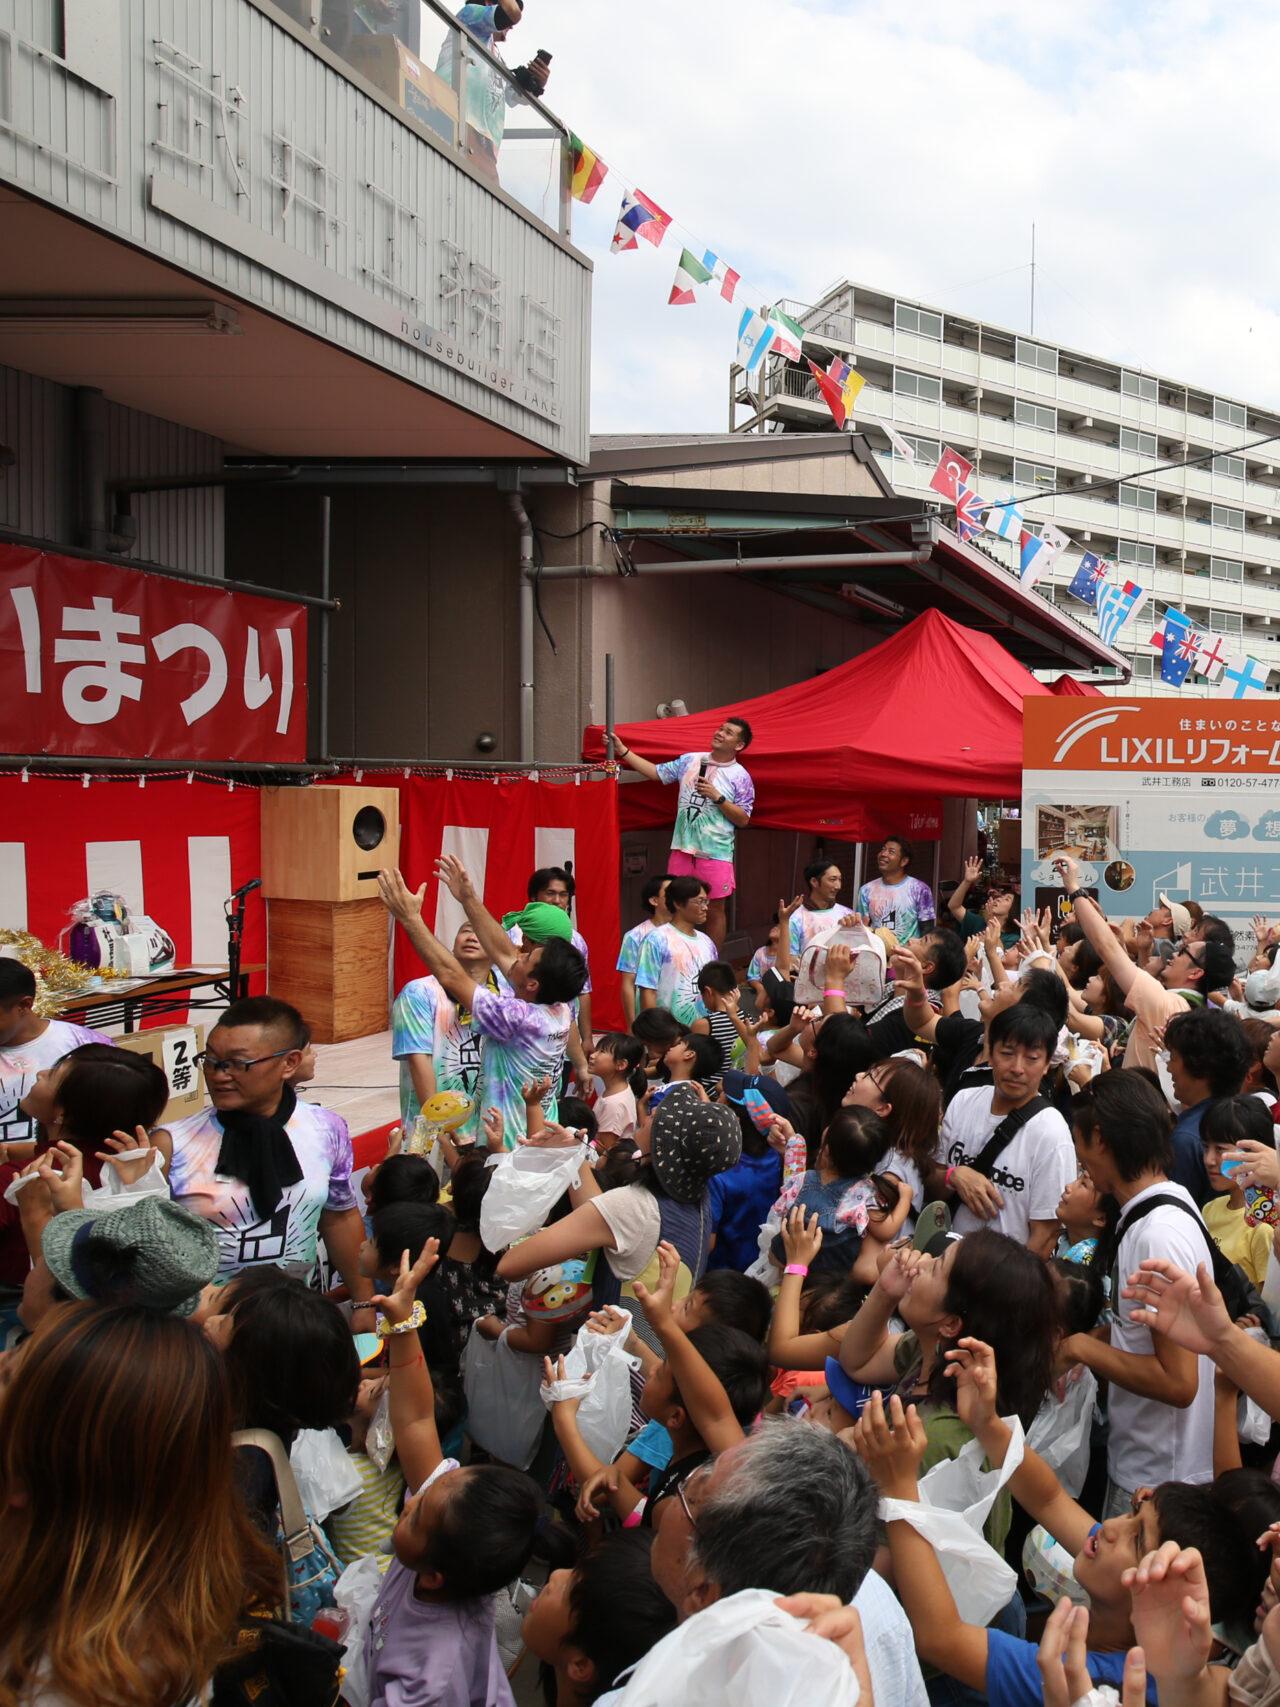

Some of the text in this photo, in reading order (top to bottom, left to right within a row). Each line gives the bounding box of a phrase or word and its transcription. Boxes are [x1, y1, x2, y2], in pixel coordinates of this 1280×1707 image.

[400, 316, 563, 421] housebuilder TAKEI
[1141, 776, 1192, 788] 武井工務店
[1219, 820, 1238, 837] 夢
[172, 1040, 192, 1091] 2等
